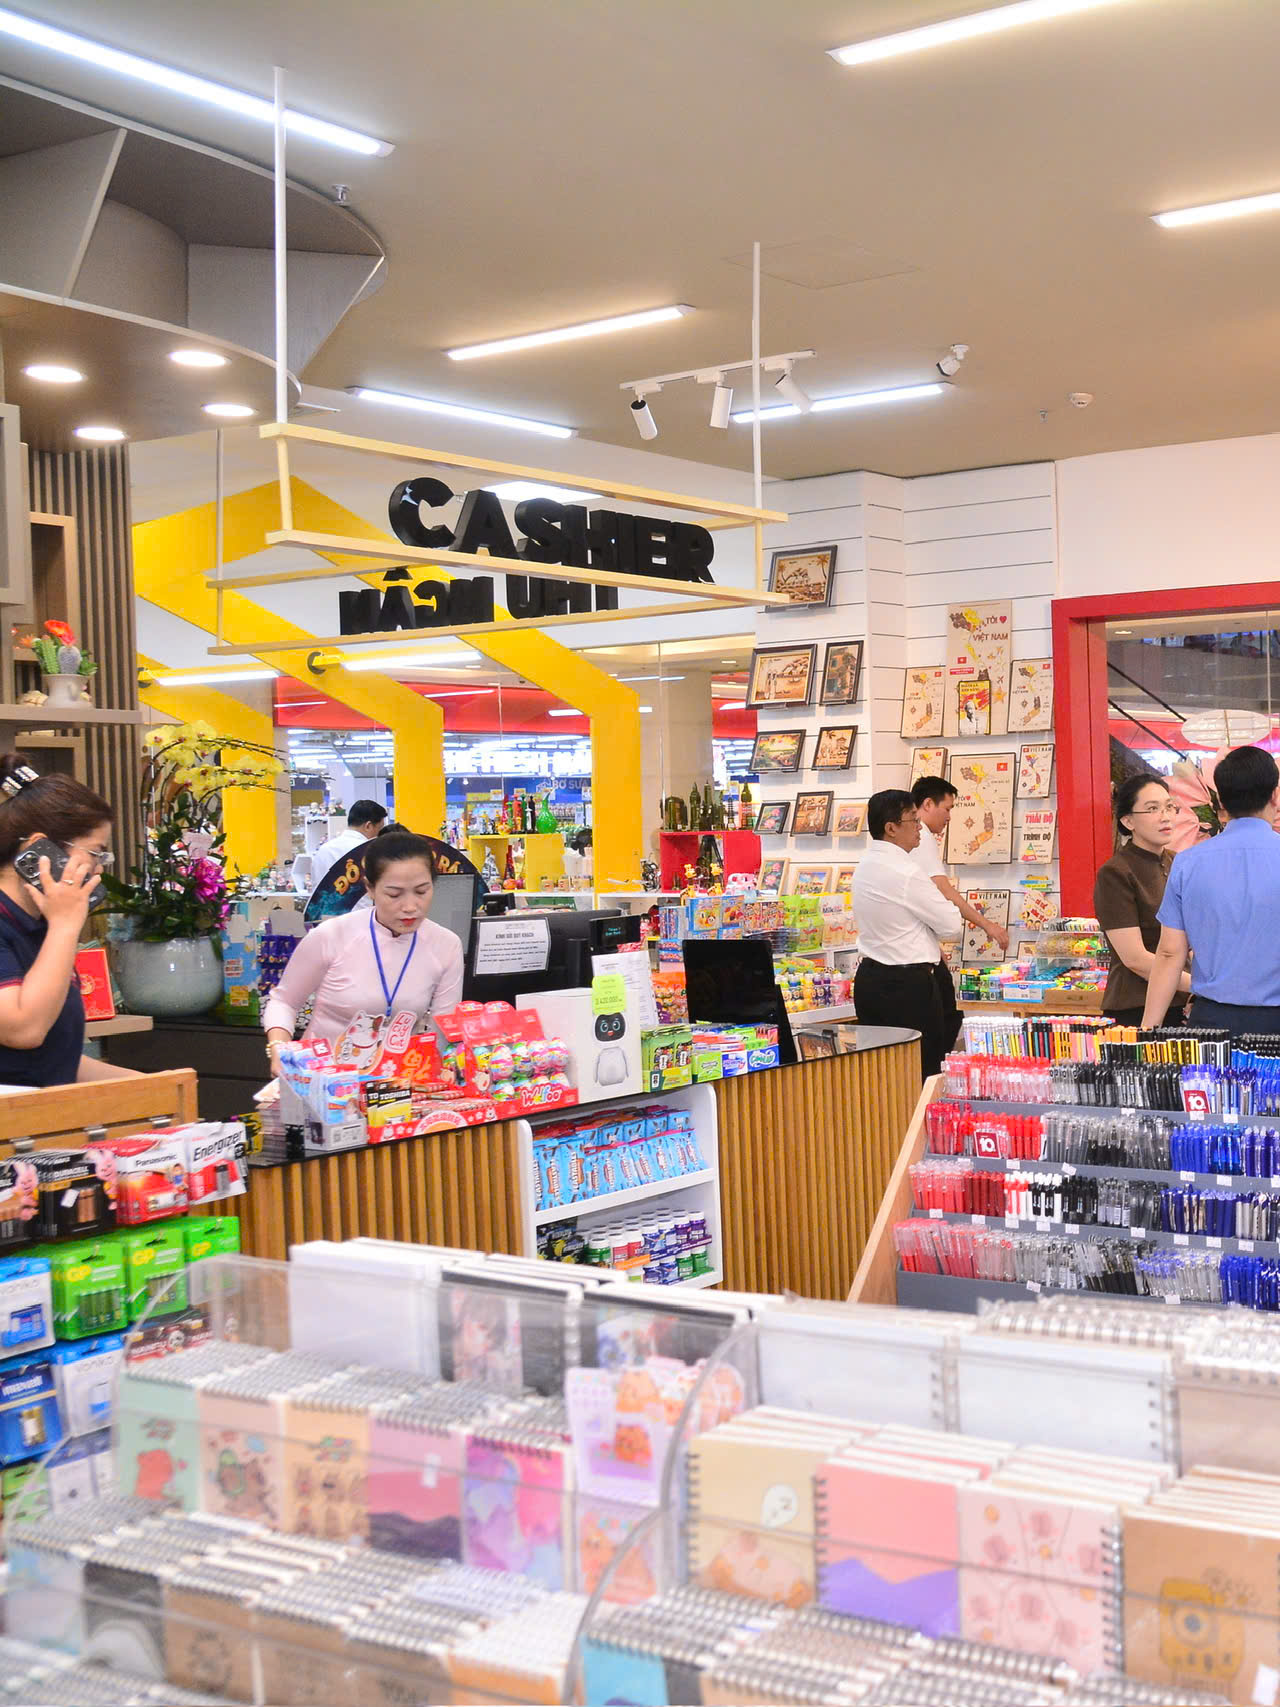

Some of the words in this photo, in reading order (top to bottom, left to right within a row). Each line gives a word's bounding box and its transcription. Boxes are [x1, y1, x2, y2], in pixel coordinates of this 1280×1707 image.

[388, 477, 716, 585] CASHIER
[991, 632, 1009, 640] NAM
[380, 1089, 411, 1099] TOSHIBA
[193, 1130, 243, 1162] Energizer
[135, 1154, 177, 1167] Panasonic
[66, 1265, 91, 1283] GP
